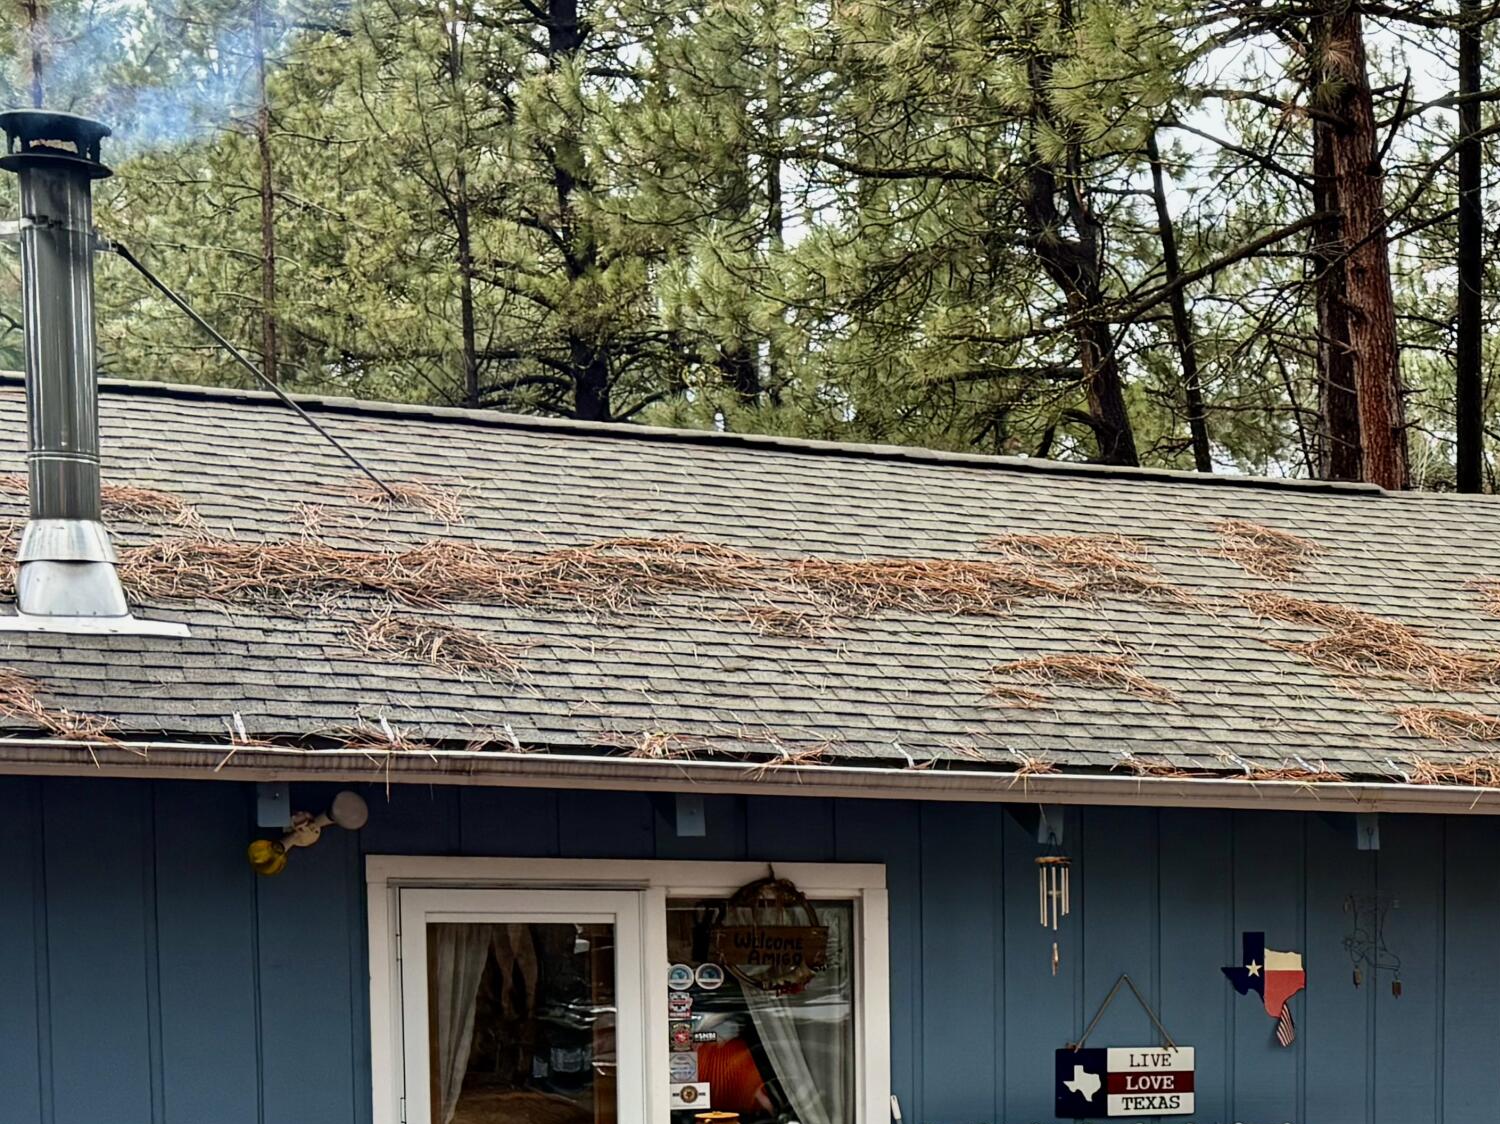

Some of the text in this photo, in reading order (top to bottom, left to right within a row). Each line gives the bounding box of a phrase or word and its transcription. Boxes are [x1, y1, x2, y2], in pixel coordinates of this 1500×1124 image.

[1129, 1053, 1171, 1067] LIVE
[1125, 1075, 1174, 1091] LOVE
[1121, 1095, 1180, 1111] TEXAS
